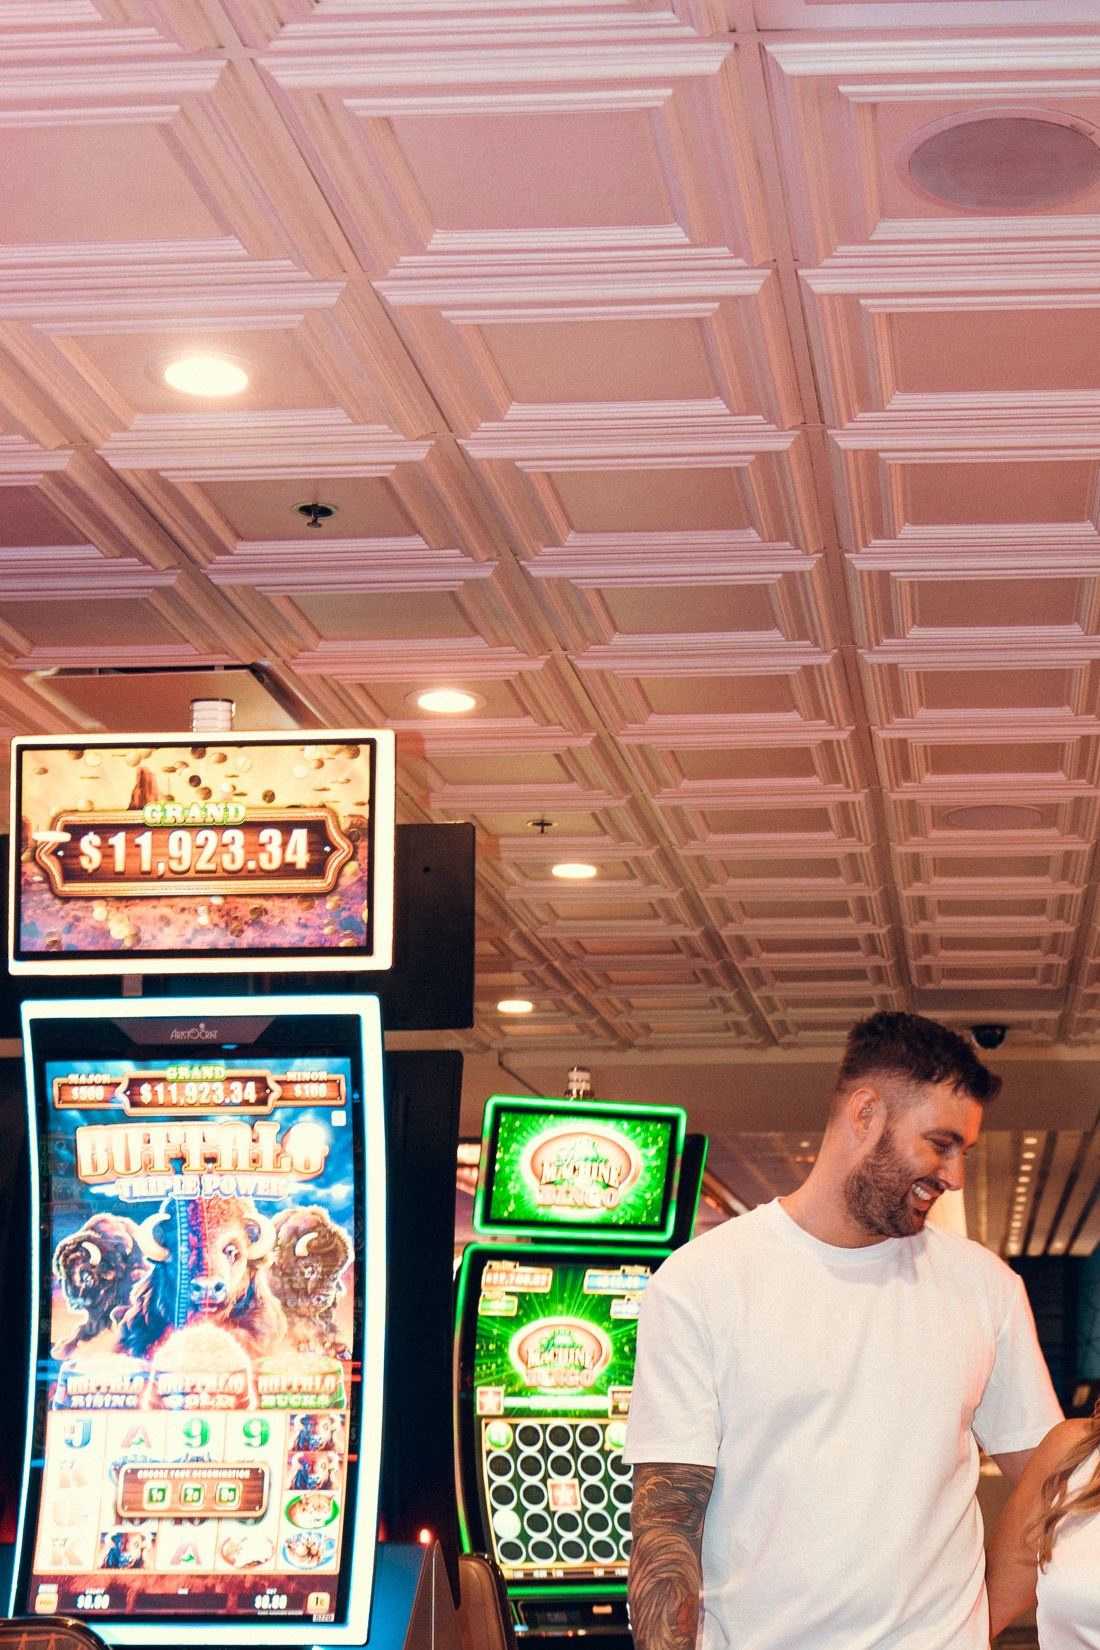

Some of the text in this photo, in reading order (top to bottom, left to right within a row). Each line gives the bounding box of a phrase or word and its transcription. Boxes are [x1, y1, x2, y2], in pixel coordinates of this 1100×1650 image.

[143, 802, 246, 826] GRAND
[79, 828, 310, 878] $11,923.34
[170, 1023, 218, 1040] ARISTOCRAT
[166, 1066, 226, 1081] GRAND
[140, 1081, 258, 1107] $11,923.34
[77, 1121, 329, 1182] BUFFALO
[541, 1161, 621, 1188] MACHINE
[116, 1175, 289, 1201] TRIPLE POWER
[537, 1184, 620, 1209] BINGO
[526, 1348, 595, 1370] MACHINE
[526, 1369, 595, 1388] BINGO
[183, 1417, 210, 1448] 9
[243, 1417, 270, 1448] 9
